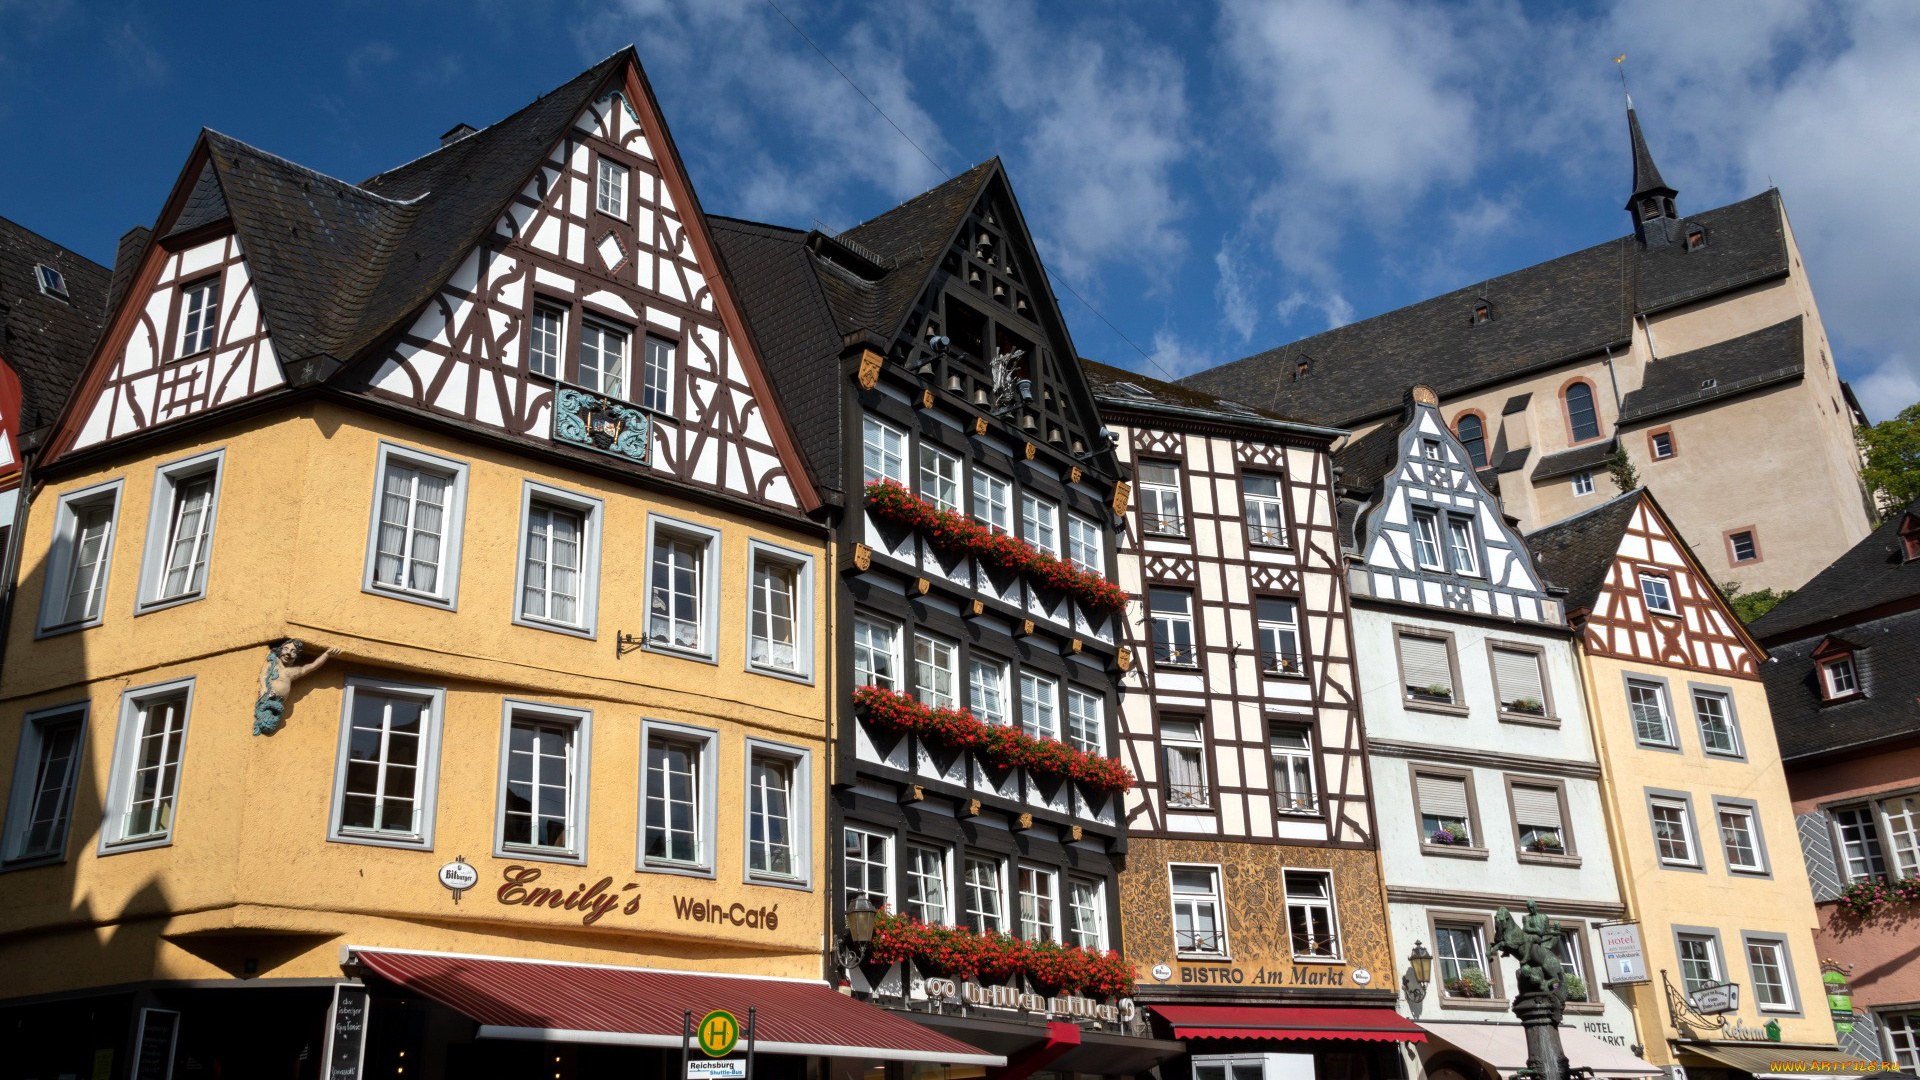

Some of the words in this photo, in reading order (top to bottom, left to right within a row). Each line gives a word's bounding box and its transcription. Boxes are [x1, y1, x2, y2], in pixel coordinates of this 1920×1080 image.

[445, 869, 473, 882] Bitburger
[1181, 967, 1244, 984] BISTRO
[1252, 966, 1283, 984] Am
[1289, 966, 1344, 986] Markt
[963, 982, 1046, 1011] brillen
[1048, 995, 1120, 1021] müller
[710, 1021, 727, 1047] H
[1584, 1022, 1613, 1034] HOTEL
[1721, 1017, 1767, 1040] Reform
[1593, 1035, 1625, 1046] ARKT
[690, 1061, 735, 1070] Reichsburg
